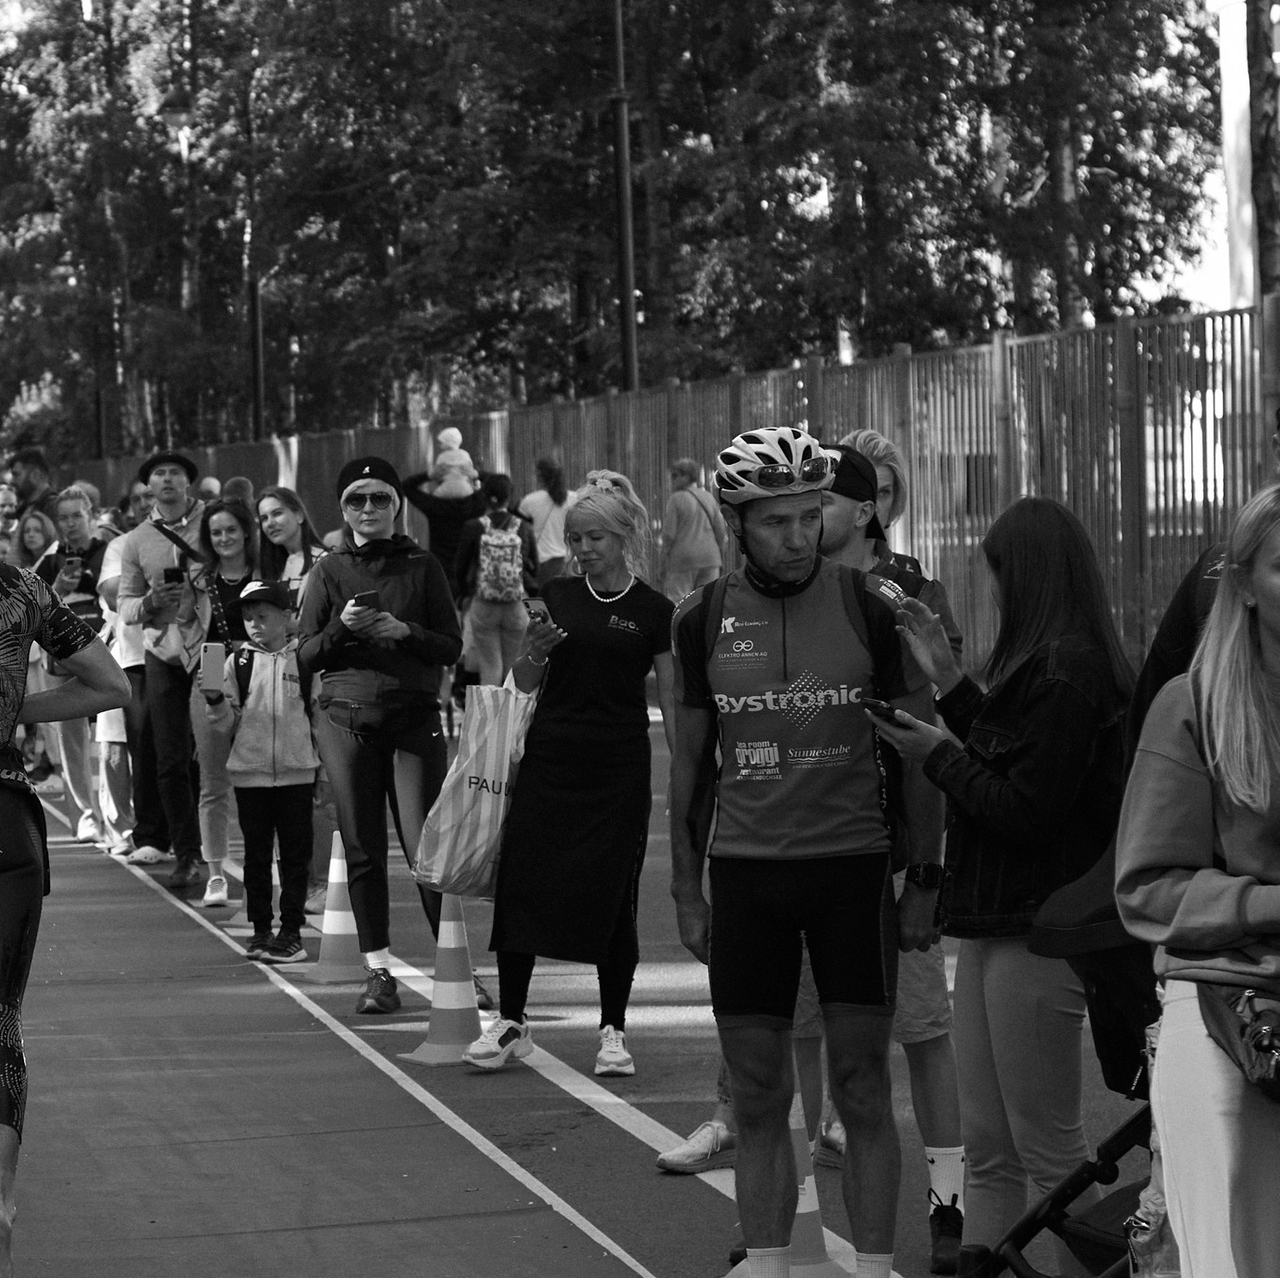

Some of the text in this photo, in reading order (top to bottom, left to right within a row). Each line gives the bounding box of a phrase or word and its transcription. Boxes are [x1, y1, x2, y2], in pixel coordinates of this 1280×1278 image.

[714, 684, 862, 713] Bystronic
[748, 740, 770, 748] room
[787, 744, 851, 758] Sunnestube
[735, 742, 780, 767] groggi
